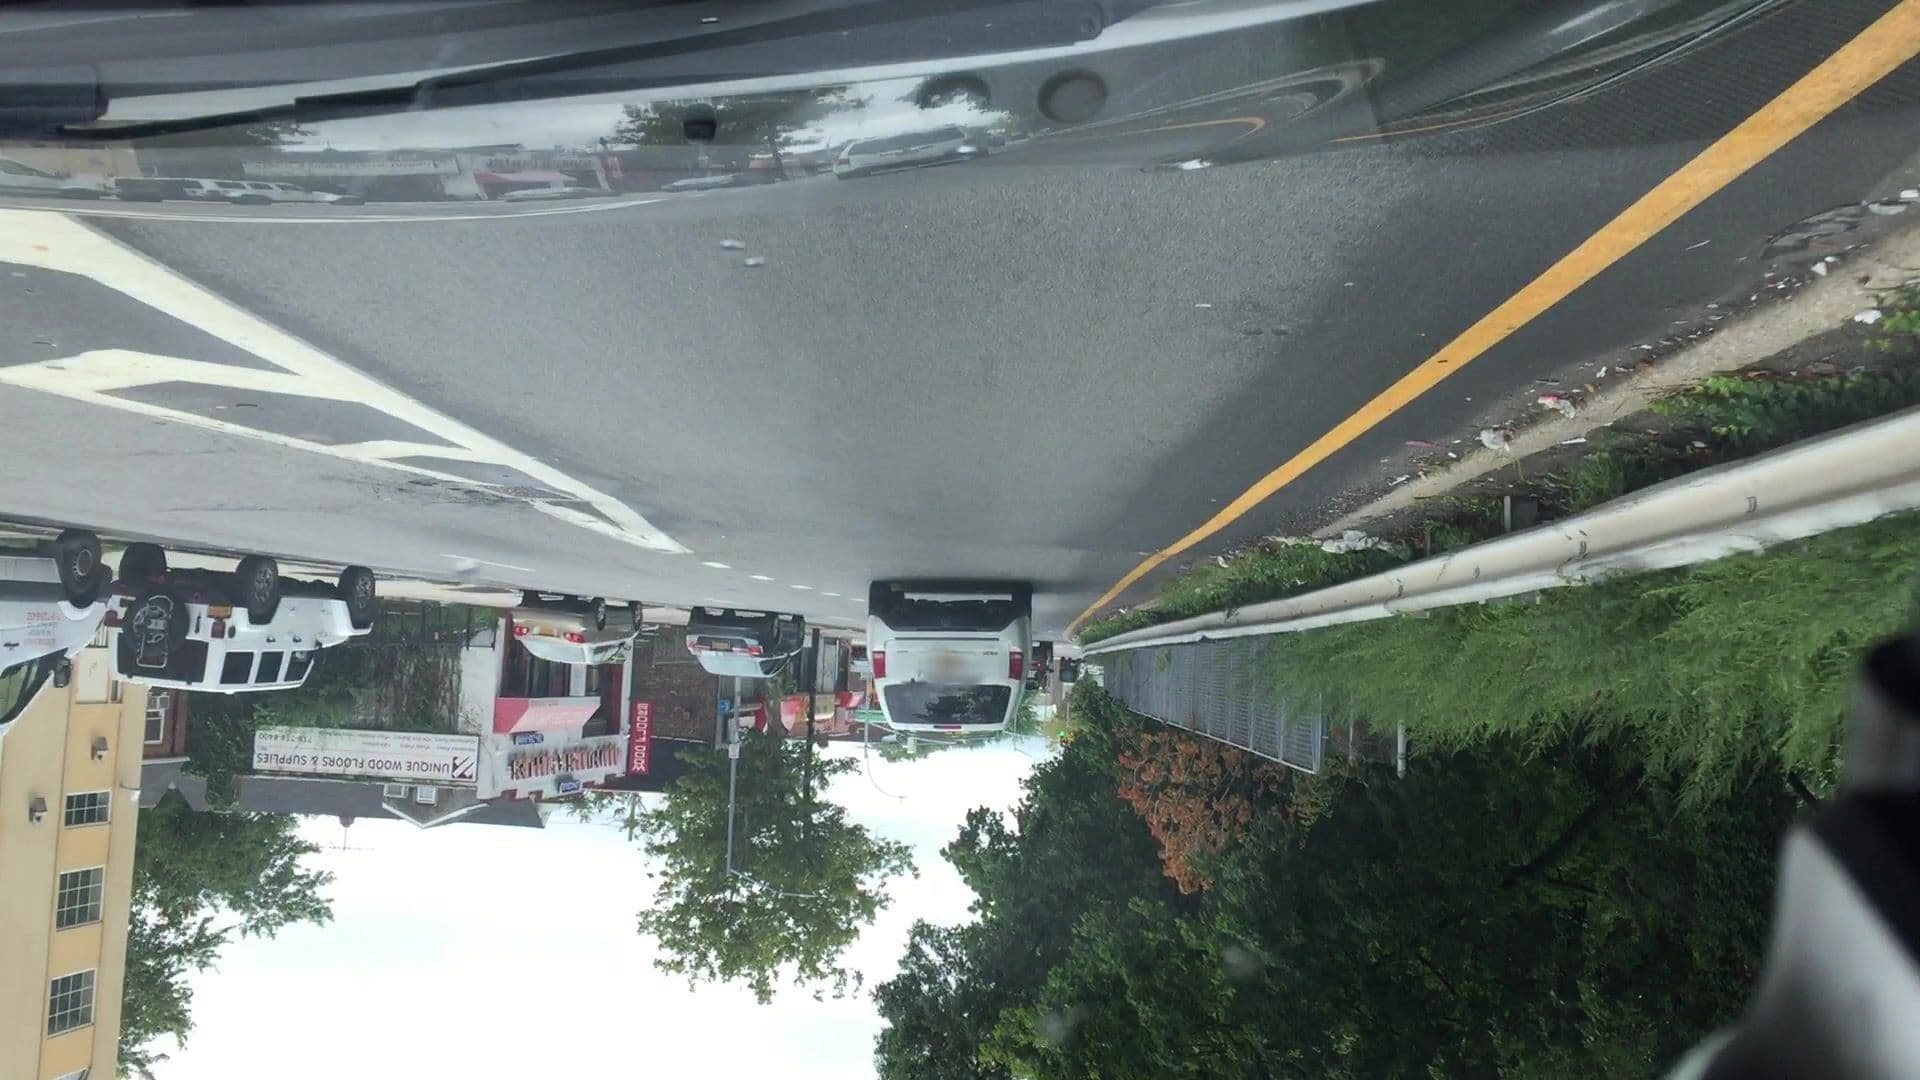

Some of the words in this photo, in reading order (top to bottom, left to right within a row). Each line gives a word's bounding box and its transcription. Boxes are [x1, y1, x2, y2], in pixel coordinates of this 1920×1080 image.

[256, 753, 307, 765] SUPPLIES
[312, 756, 319, 766] &
[322, 756, 364, 768] FLOORS
[368, 759, 402, 770] WOOD
[632, 745, 646, 772] WOOD
[406, 761, 449, 774] UNIQUE
